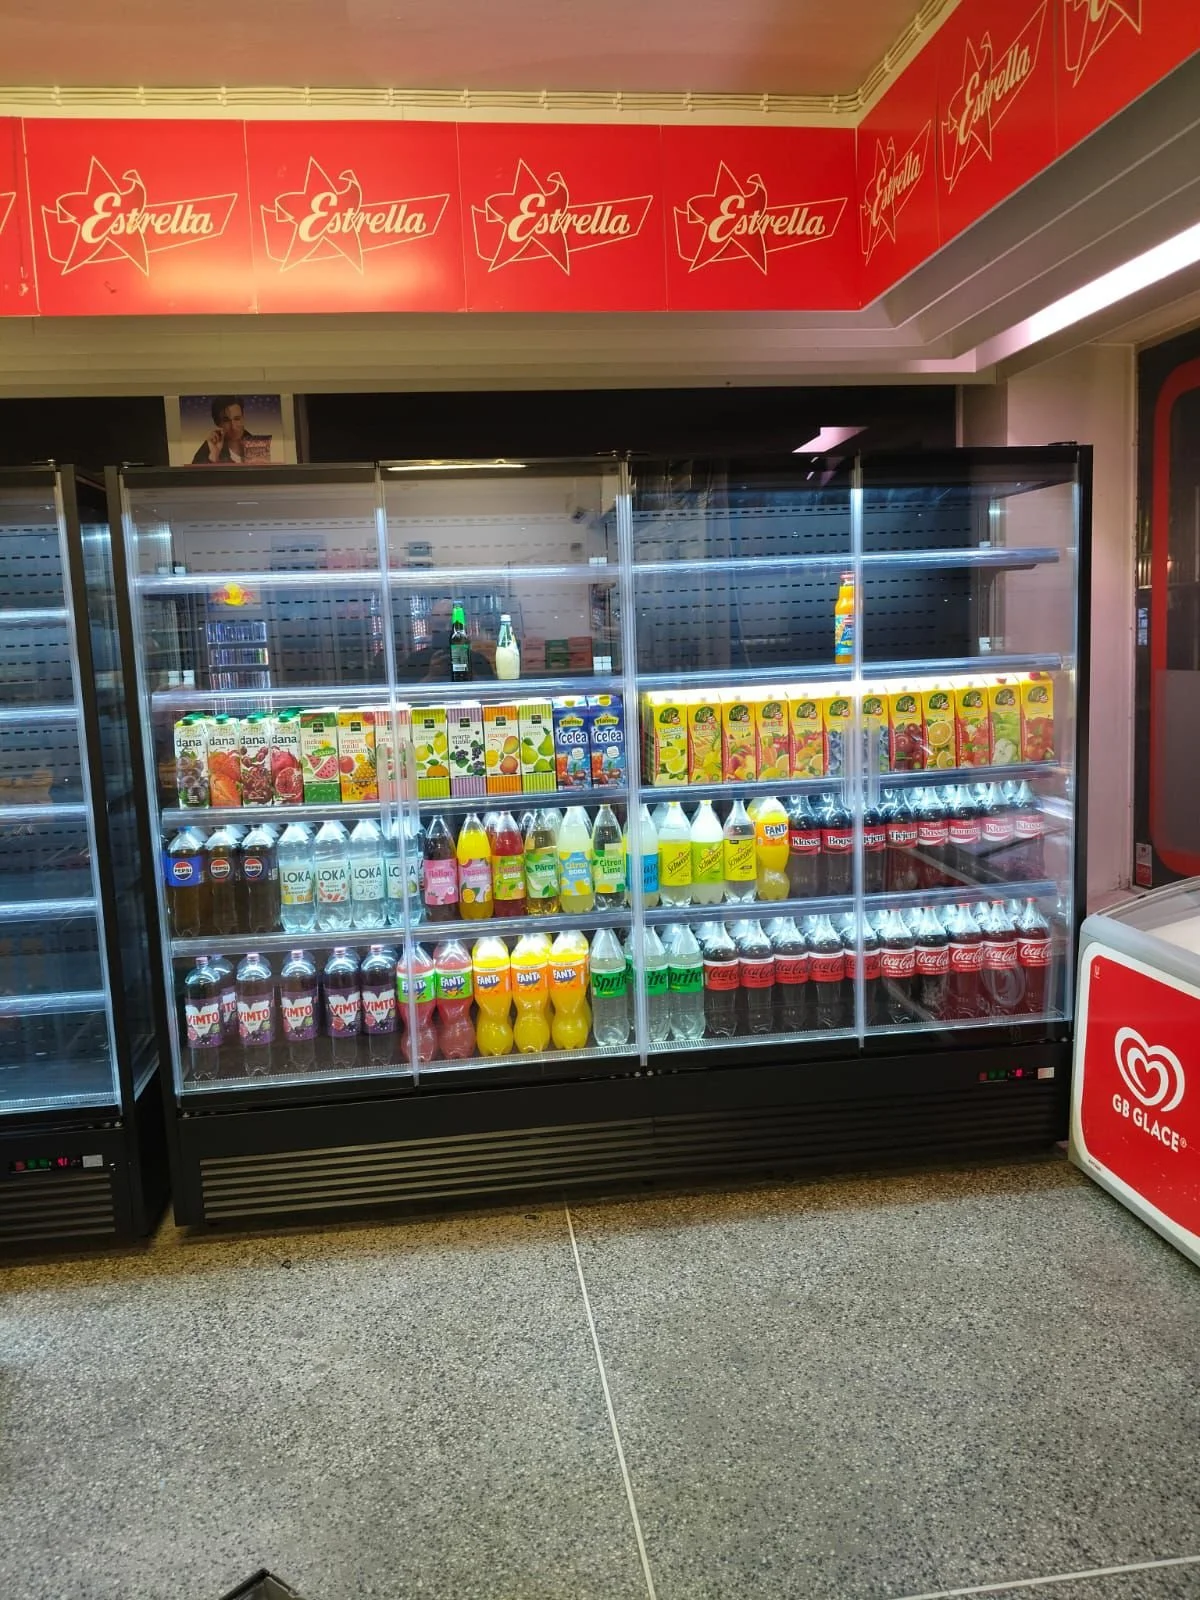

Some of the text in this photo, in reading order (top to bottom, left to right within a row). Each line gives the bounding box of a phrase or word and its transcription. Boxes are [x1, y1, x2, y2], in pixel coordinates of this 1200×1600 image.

[959, 42, 1031, 145] Estrella
[871, 153, 921, 227] Estrella
[81, 192, 215, 244] Estrella
[299, 192, 427, 243] Estrella
[507, 193, 631, 243] Estrella
[707, 195, 826, 243] Estrella
[176, 737, 202, 748] dana
[209, 736, 235, 746] dana
[240, 735, 265, 745] dana
[272, 734, 297, 744] dana
[564, 861, 588, 869] Citron
[599, 858, 622, 867] Citron
[283, 870, 311, 883] LOKA
[317, 868, 346, 881] LOKA
[354, 867, 382, 879] LOKA
[388, 864, 416, 877] LOA
[568, 868, 587, 876] SODA
[602, 866, 621, 874] Lime
[477, 973, 500, 987] FANTA
[516, 971, 541, 985] FANTA
[552, 968, 577, 982] FANTA
[670, 968, 702, 986] prite
[440, 975, 465, 989] FANTA
[1112, 1093, 1130, 1119] GB
